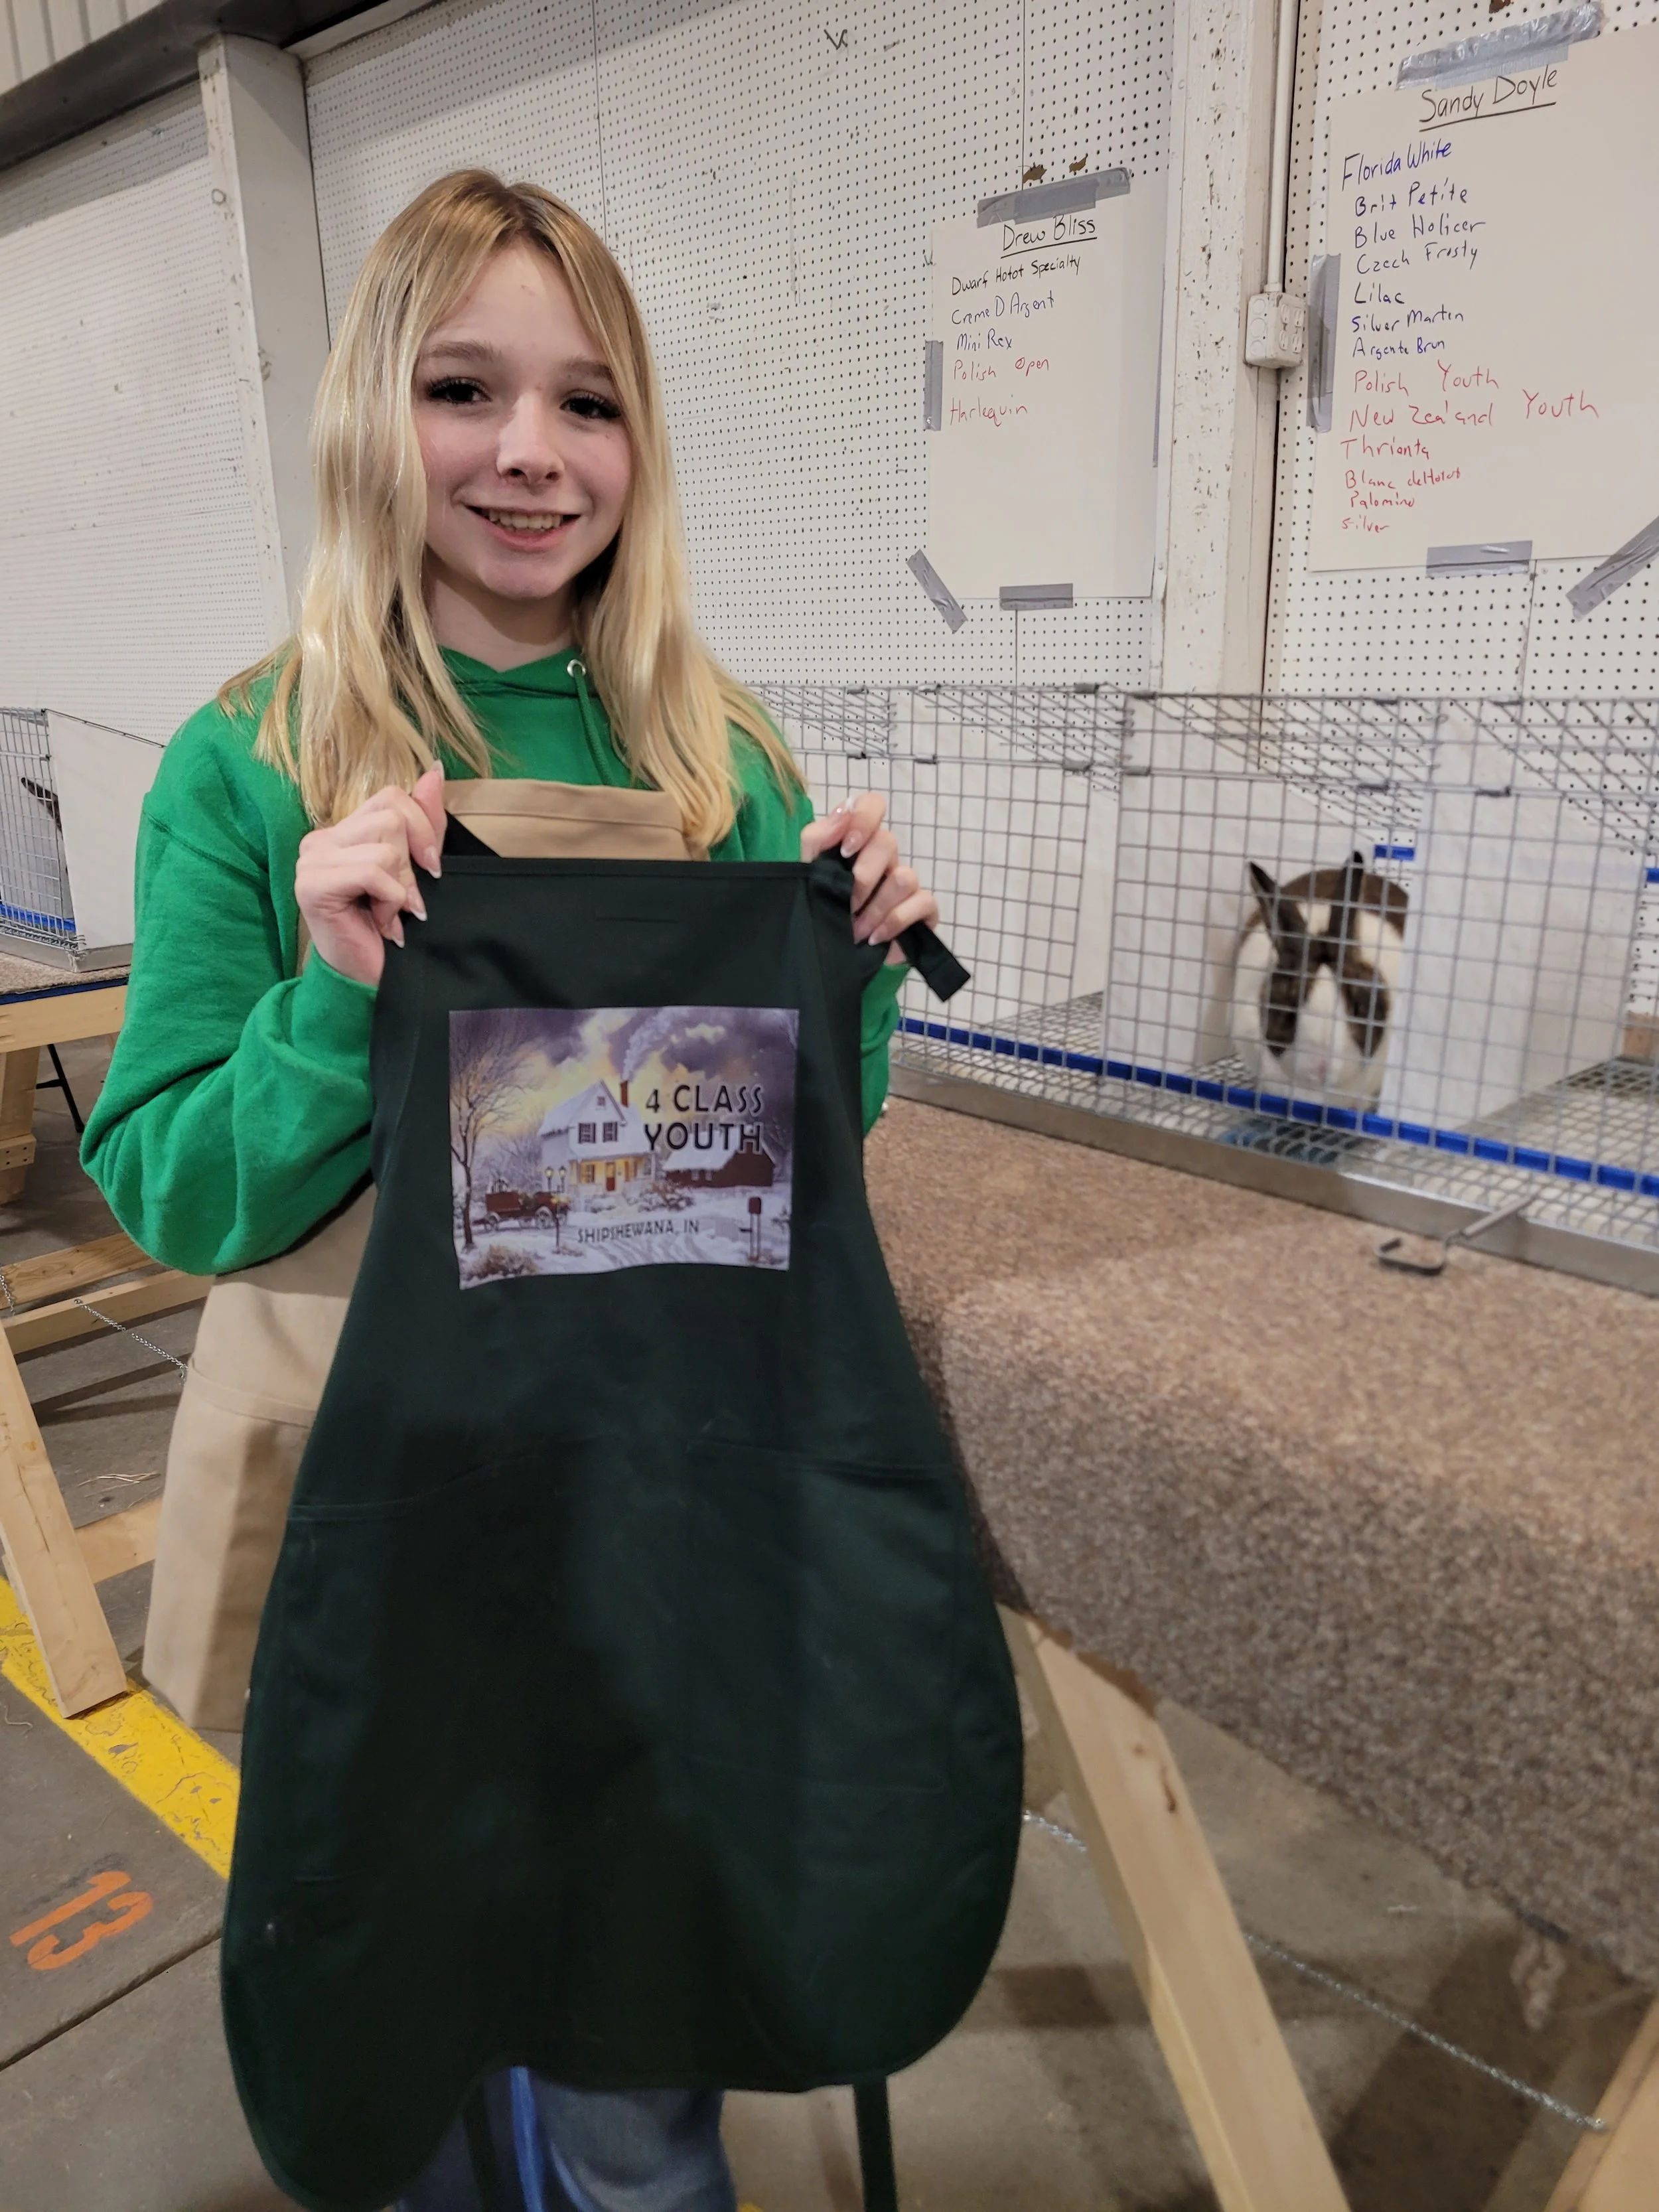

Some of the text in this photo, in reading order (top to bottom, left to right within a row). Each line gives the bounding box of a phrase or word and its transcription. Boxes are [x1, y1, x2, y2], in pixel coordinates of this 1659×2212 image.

[1419, 63, 1559, 123] Sandy Doyle
[1340, 137, 1453, 191] Florida White
[1354, 177, 1469, 218] Brit Petite
[1002, 215, 1096, 251] Drew Bliss
[1354, 220, 1396, 250] Blue
[1356, 240, 1479, 275] Czech Frosty
[951, 254, 1082, 296] Dwarf Hotot Specialty
[1352, 281, 1406, 305] Lilac
[950, 308, 989, 325] Creme
[1351, 312, 1400, 333] Silver
[956, 328, 1013, 352] Mini Rex
[1351, 336, 1445, 361] Argente Brun
[953, 356, 1050, 381] Polish Open
[1353, 358, 1500, 397] Polish Youth
[950, 394, 1029, 427] Harlequin
[1348, 403, 1395, 433] New
[1522, 388, 1601, 421] Youth
[1344, 469, 1396, 490] Blanc
[1349, 490, 1415, 510] Palomino
[646, 1084, 762, 1114] 4 CLASS
[644, 1121, 762, 1153] YOUTH
[684, 1218, 699, 1234] IN
[9, 1870, 154, 1971] 13
